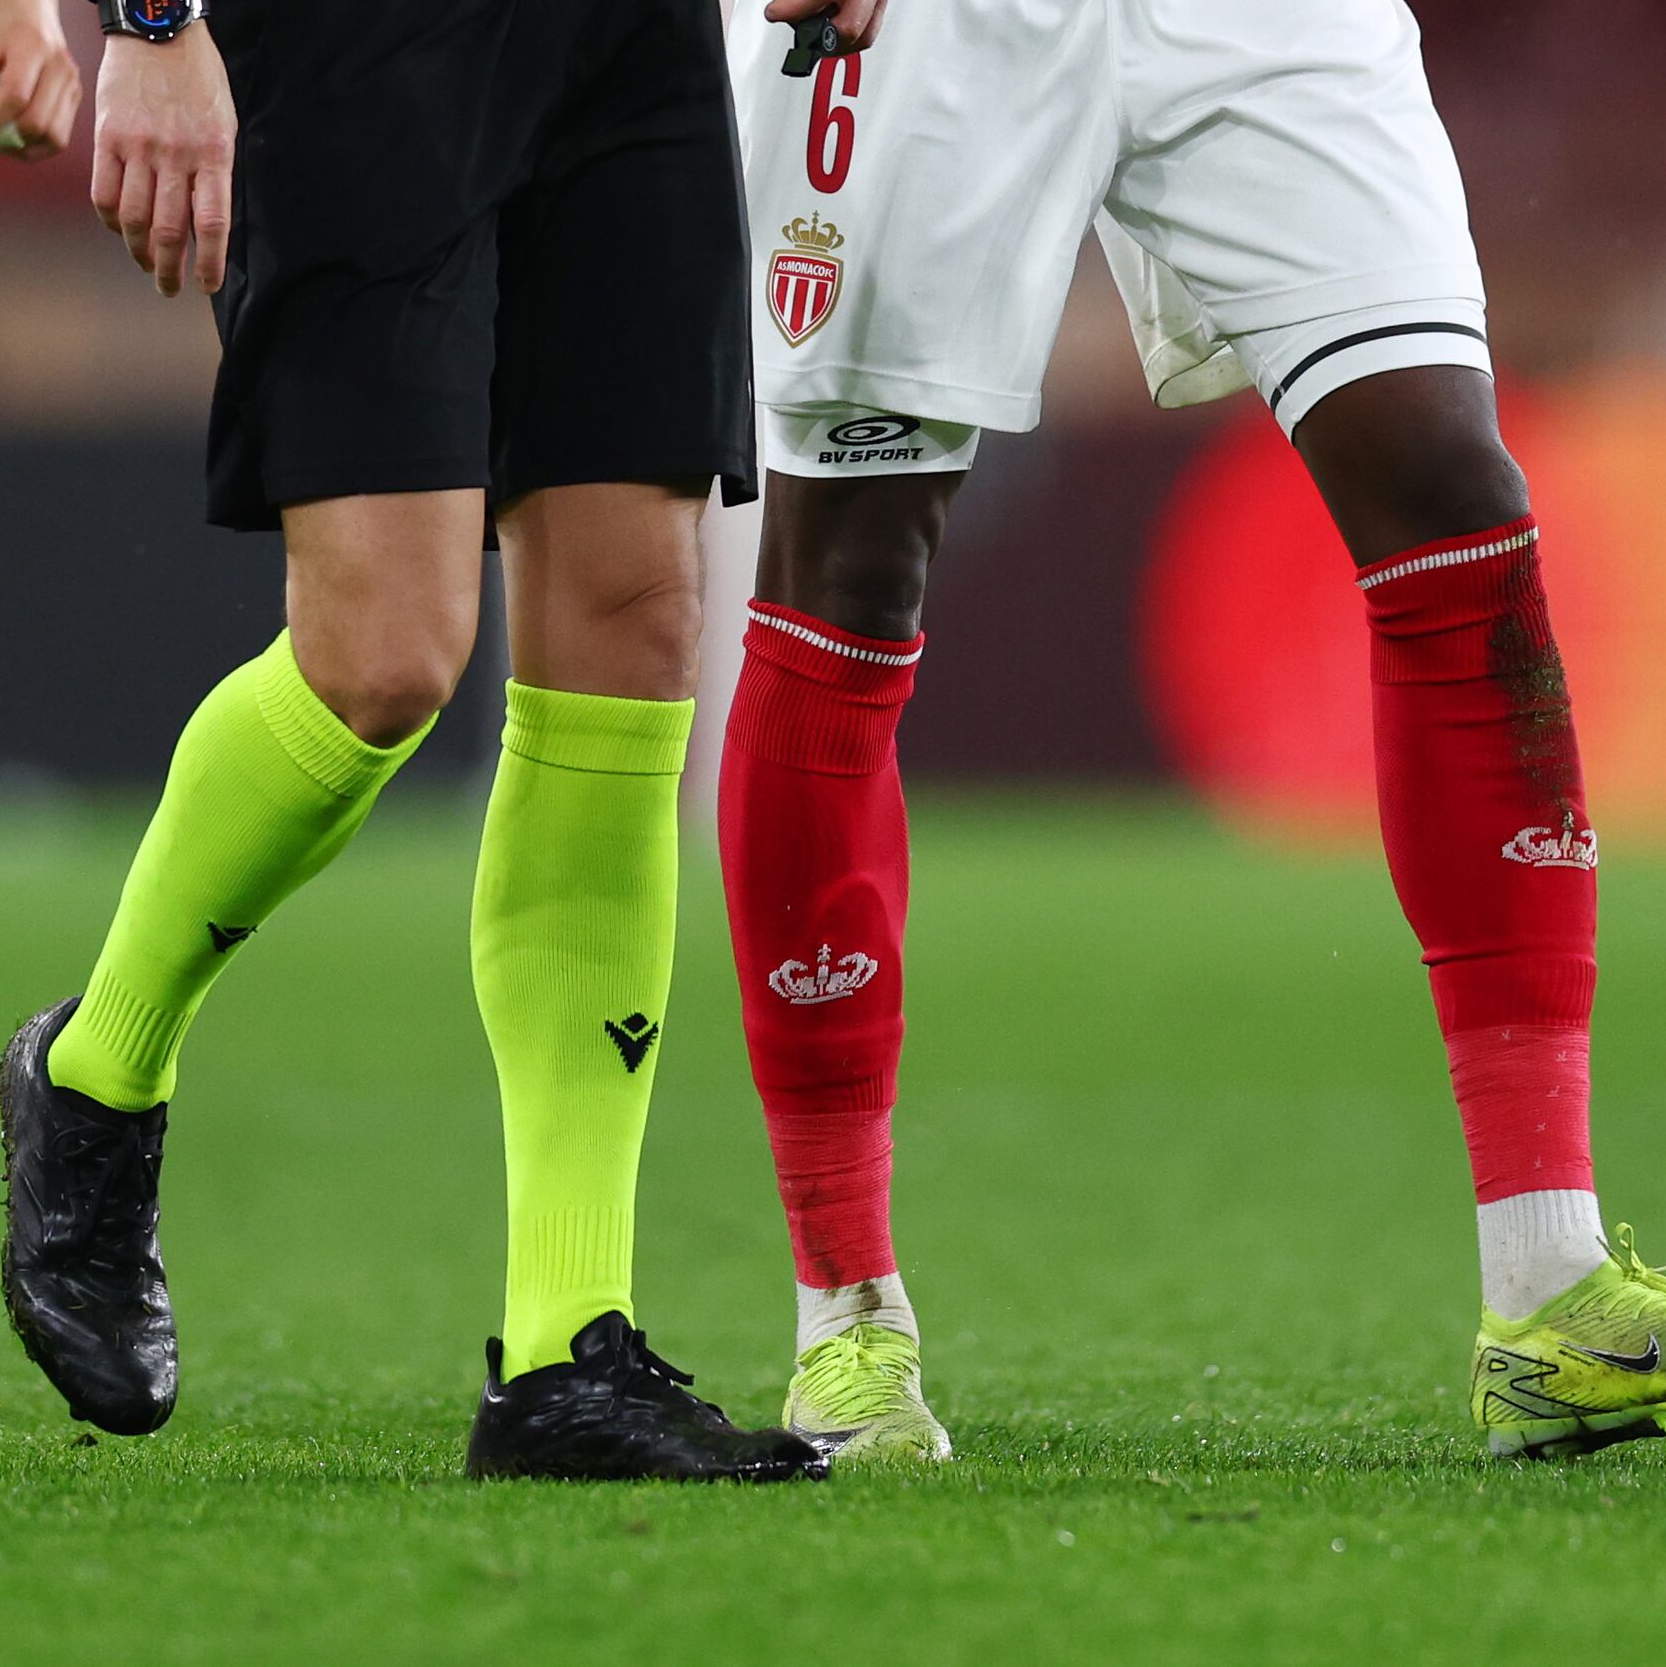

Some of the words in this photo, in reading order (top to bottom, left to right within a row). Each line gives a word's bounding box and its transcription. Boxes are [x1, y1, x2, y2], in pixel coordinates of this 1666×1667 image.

[805, 50, 862, 194] 6
[818, 450, 848, 464] BV
[849, 447, 924, 462] SPORT
